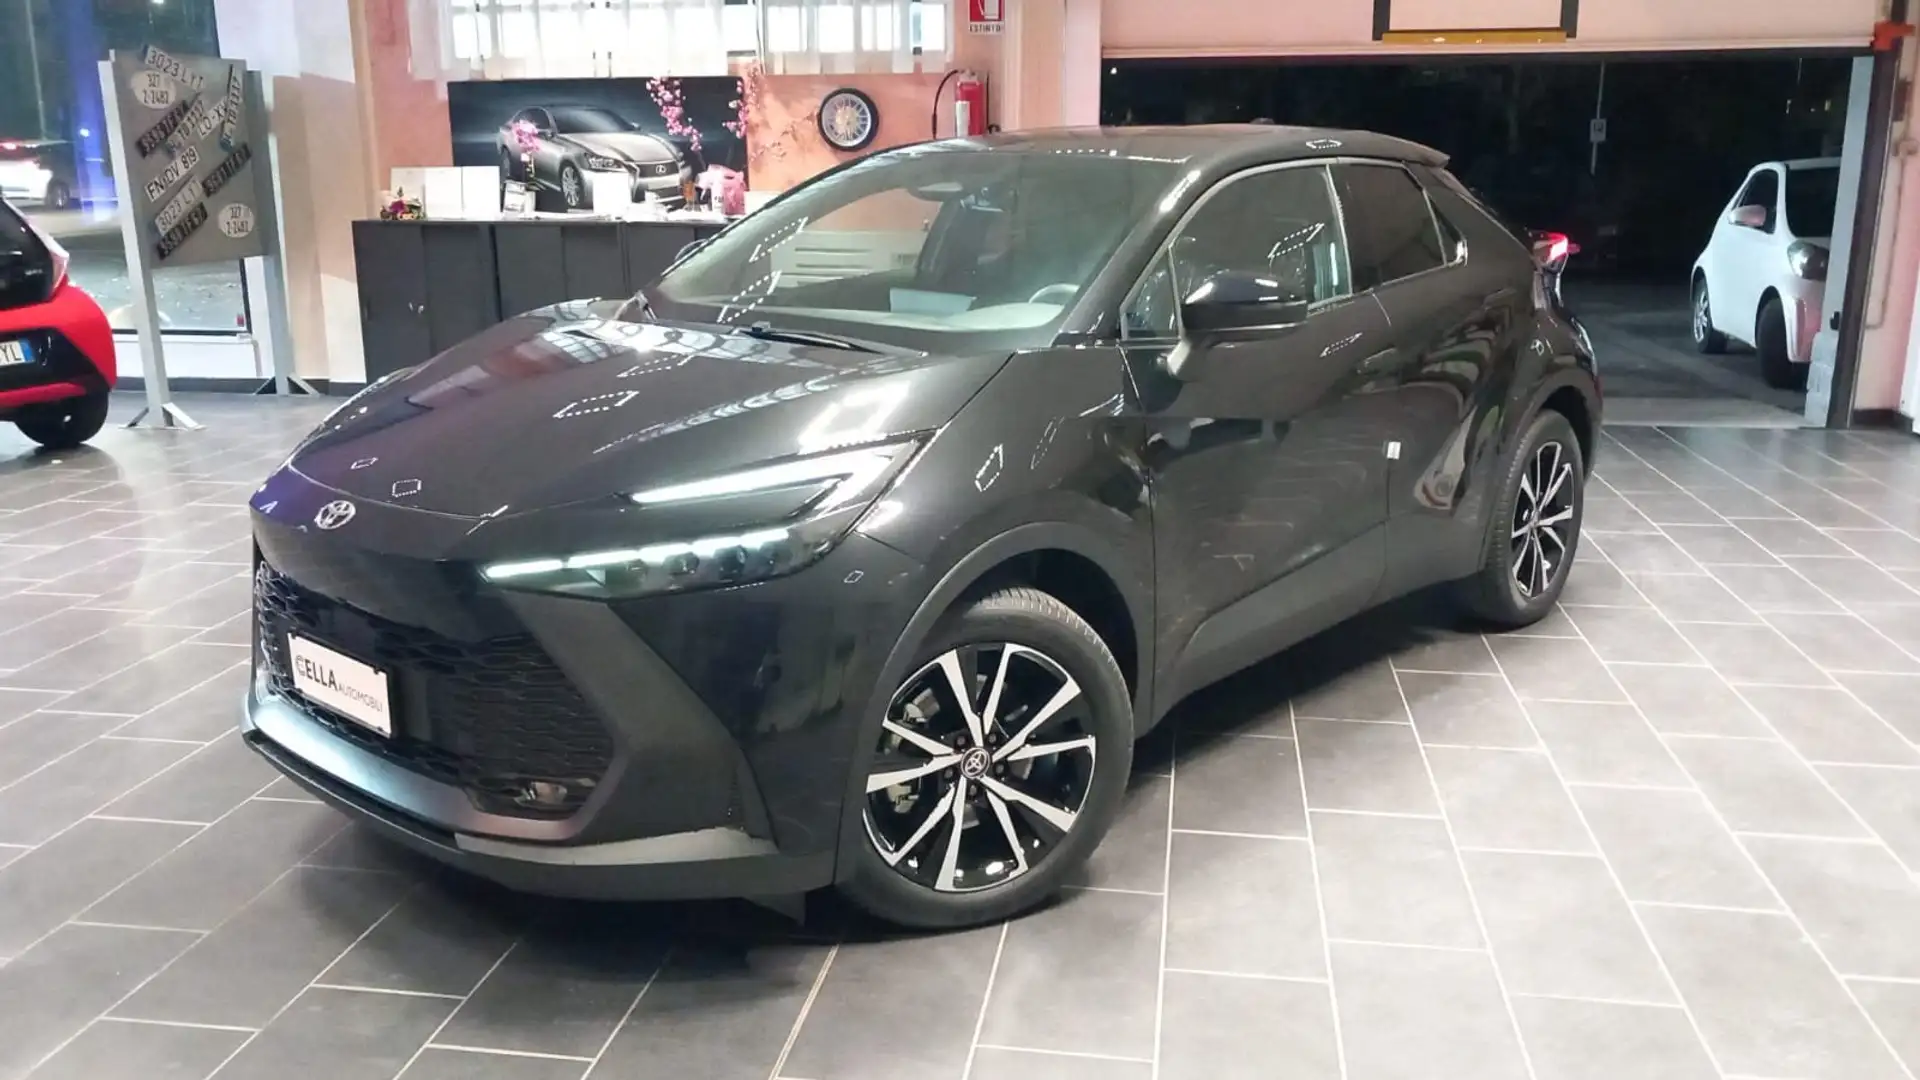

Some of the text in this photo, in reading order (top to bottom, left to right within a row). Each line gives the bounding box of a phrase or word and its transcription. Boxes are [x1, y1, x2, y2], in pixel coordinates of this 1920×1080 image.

[147, 49, 180, 77] 3023
[295, 654, 383, 713] CELLA AUTOMOBILI
